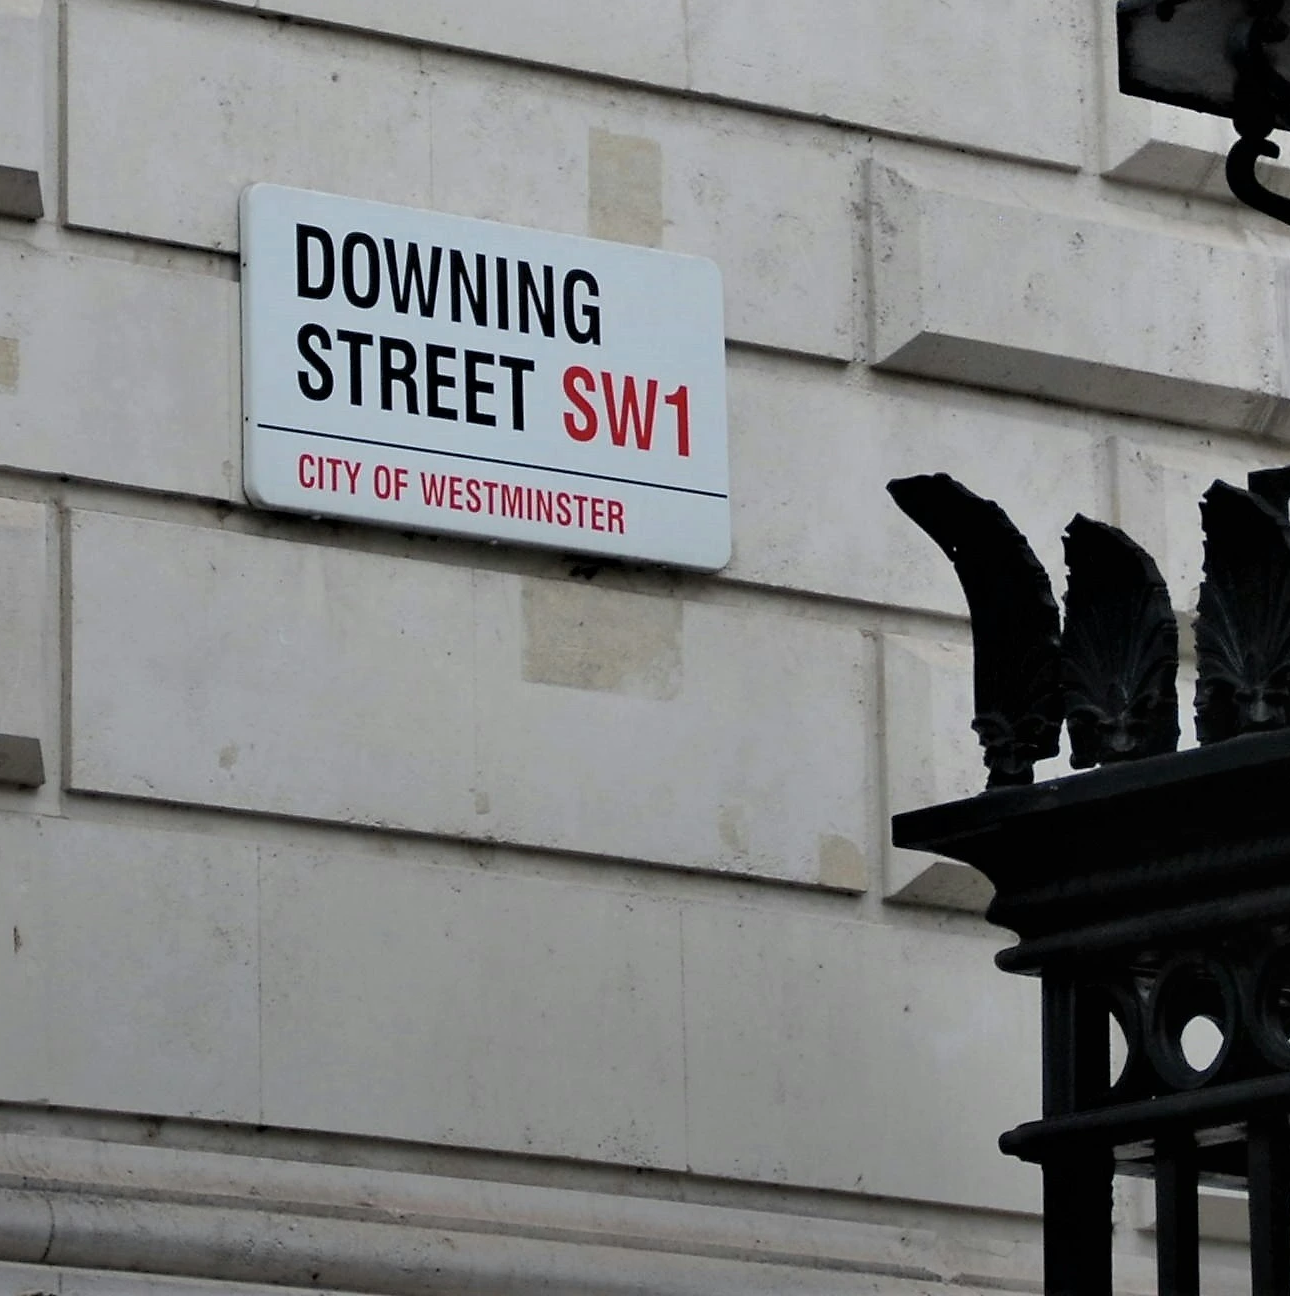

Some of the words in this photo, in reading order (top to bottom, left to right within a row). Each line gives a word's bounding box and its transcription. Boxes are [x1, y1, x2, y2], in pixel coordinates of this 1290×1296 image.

[296, 223, 601, 346] DOWNING
[297, 323, 535, 432] STREET
[563, 365, 690, 458] SW1
[298, 454, 362, 494] CITY
[374, 465, 408, 500] OF
[421, 472, 625, 534] WESTMINSTER
